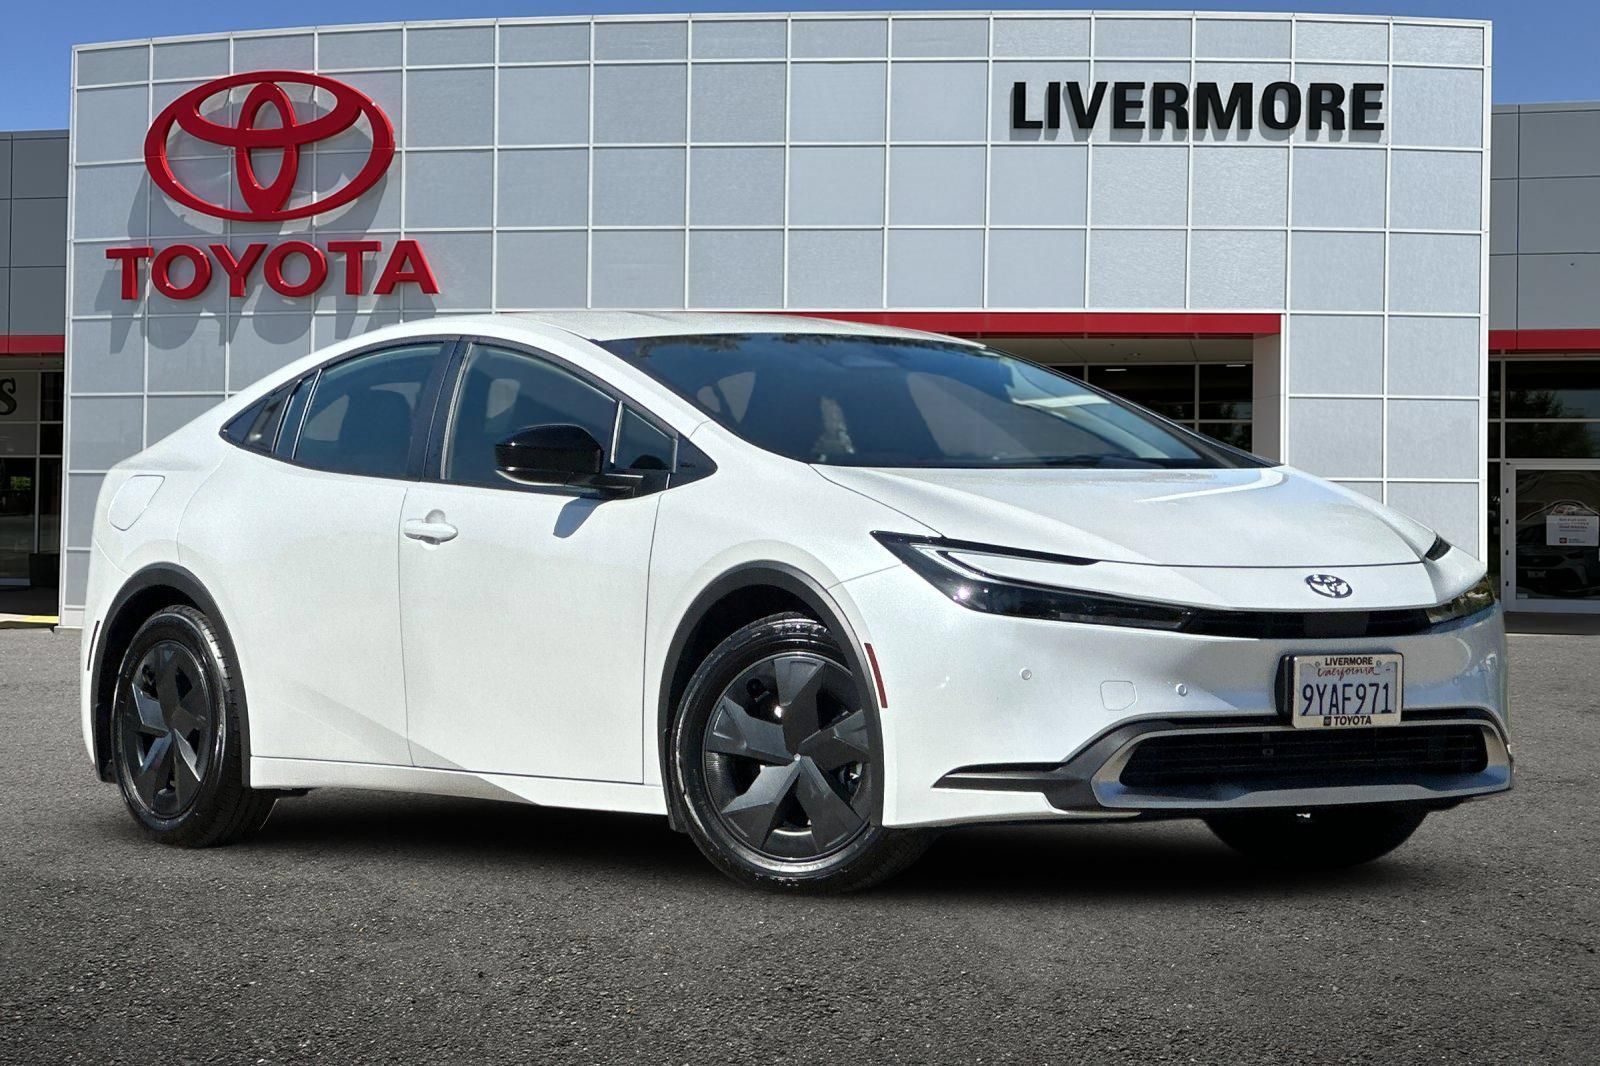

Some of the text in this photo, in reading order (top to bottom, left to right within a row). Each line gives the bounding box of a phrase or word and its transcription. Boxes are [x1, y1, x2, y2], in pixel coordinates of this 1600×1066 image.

[1011, 81, 1385, 131] LIVERMORE
[106, 240, 440, 300] TOYOTA
[1325, 657, 1373, 666] LIVERMORE
[1317, 667, 1381, 681] California
[1302, 683, 1392, 716] 9YAF971
[1334, 716, 1372, 726] TOYOTA
